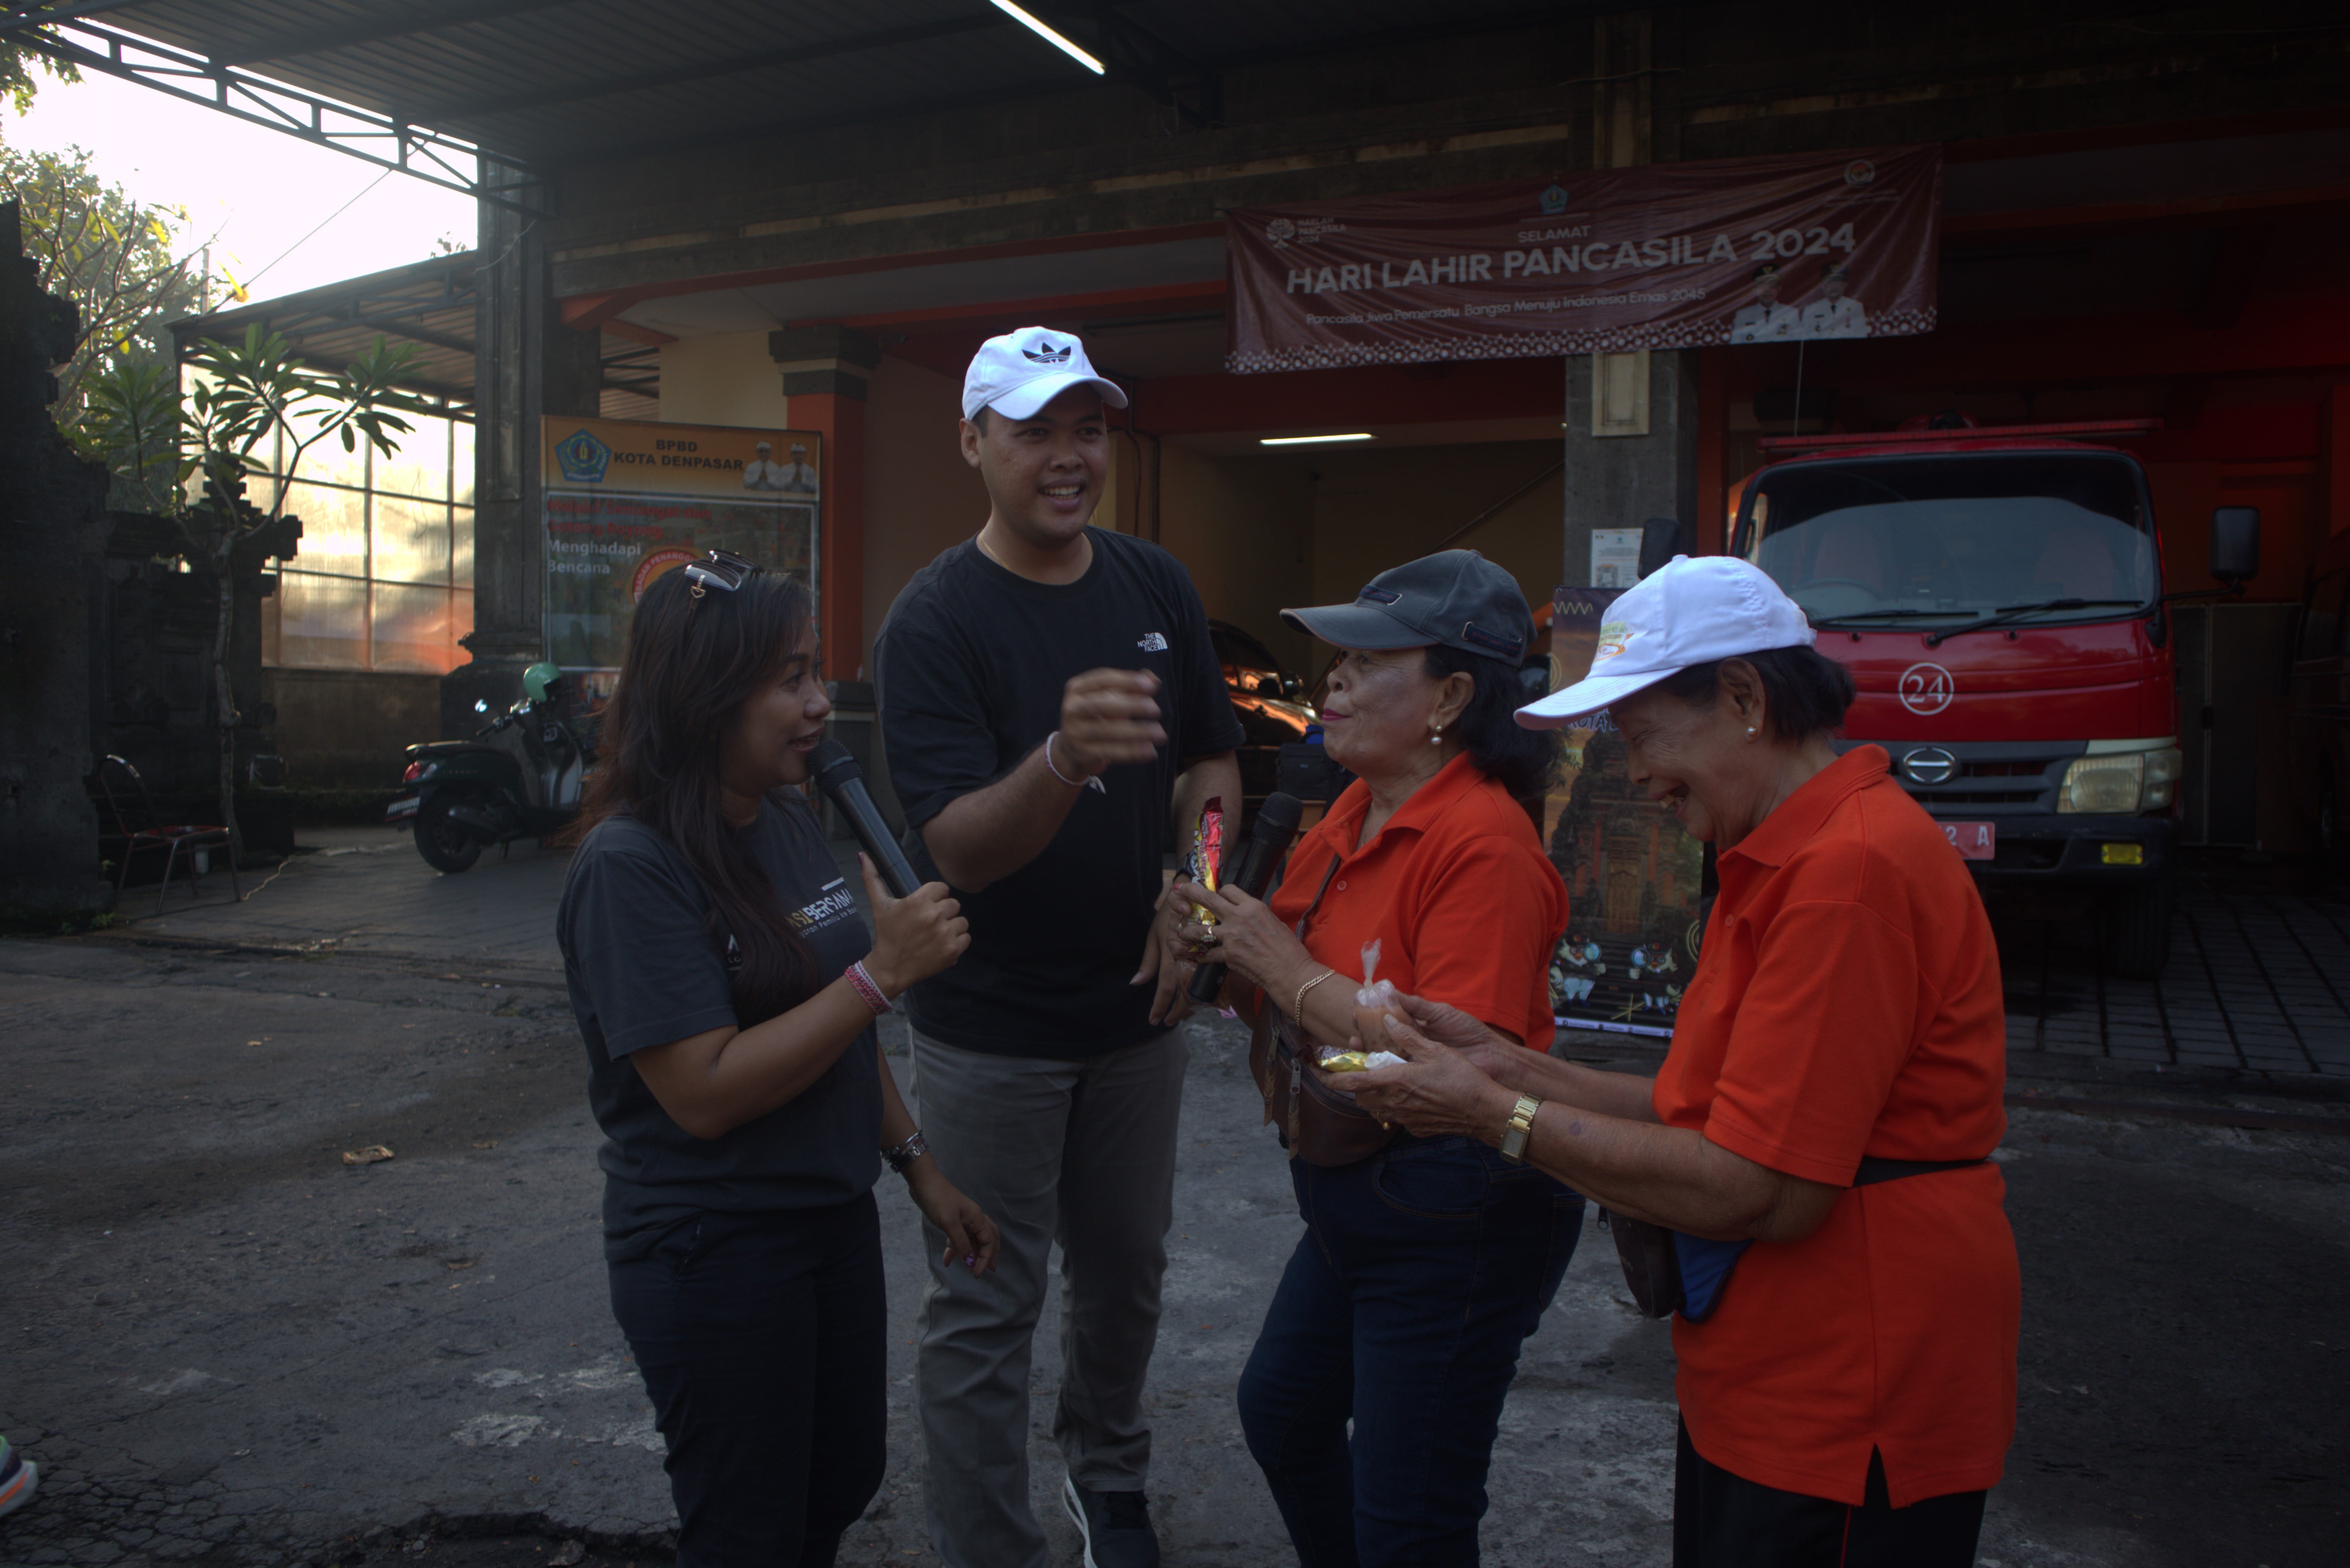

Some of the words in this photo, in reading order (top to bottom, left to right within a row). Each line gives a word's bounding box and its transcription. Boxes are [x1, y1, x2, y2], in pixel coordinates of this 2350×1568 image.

[1298, 216, 1335, 227] HARLAH
[1298, 223, 1346, 235] PANCASILA
[1518, 225, 1592, 244] SELAMAT
[1287, 263, 1372, 294] HARI
[1382, 254, 1492, 288] LAHIR
[1503, 234, 1738, 278] PANCASILA
[1750, 223, 1856, 261] 2024
[1306, 313, 1364, 325] Pancasila
[1365, 311, 1393, 323] Jiwa
[1394, 307, 1459, 321] Pemersatu
[1464, 303, 1512, 317] Bangsa
[1514, 298, 1561, 313] Menuju
[1563, 293, 1626, 308] Indonesia
[1629, 290, 1668, 303] Emas
[1670, 288, 1706, 301] 2045
[656, 440, 698, 452] BPBD
[614, 452, 656, 465] KOTA
[661, 455, 743, 470] DENPASAR
[547, 499, 601, 514] Melalui
[605, 502, 679, 520] Semangat
[683, 506, 711, 519] dan
[547, 520, 603, 537] Gotong
[607, 522, 663, 540] Royong
[548, 539, 641, 558] Menghadapi
[548, 560, 611, 575] Bencana
[635, 563, 651, 592] BADAN
[1137, 639, 1157, 648] NORTH
[1906, 674, 1946, 703] 24
[1977, 825, 1990, 846] A
[818, 915, 840, 929] Pemilu
